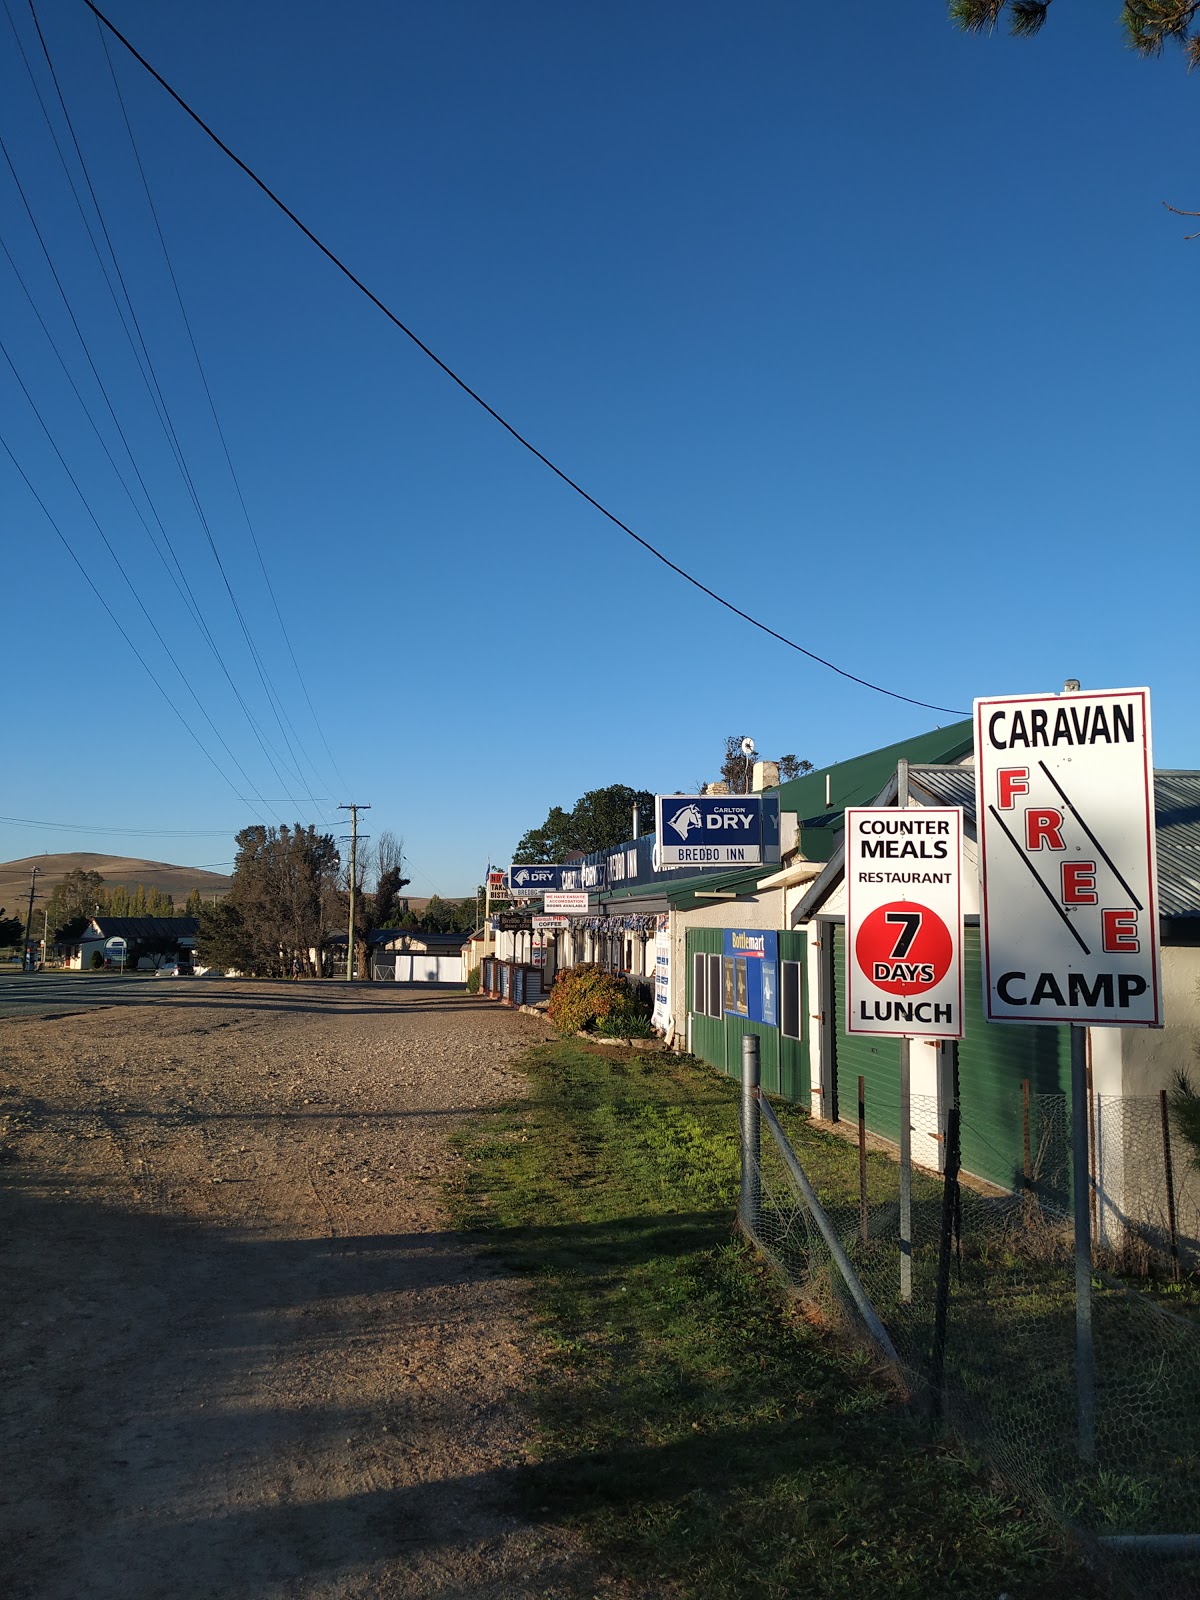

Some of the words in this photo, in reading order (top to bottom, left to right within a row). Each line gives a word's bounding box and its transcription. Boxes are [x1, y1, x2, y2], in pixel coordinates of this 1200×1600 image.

[988, 703, 1135, 750] CARAVAN
[706, 814, 754, 829] DRY
[859, 820, 950, 836] COUNTER
[678, 848, 720, 860] BREDBO
[726, 848, 745, 860] INN
[861, 840, 949, 859] MEALS
[627, 848, 638, 878] INN
[996, 766, 1141, 954] FREE
[531, 873, 554, 881] DRY
[858, 872, 952, 884] RESTAURANT
[732, 932, 765, 951] Bottlemart
[885, 912, 922, 960] 7
[873, 961, 935, 983] DAYS
[996, 971, 1148, 1008] CAMP
[860, 1000, 952, 1024] LUNCH
